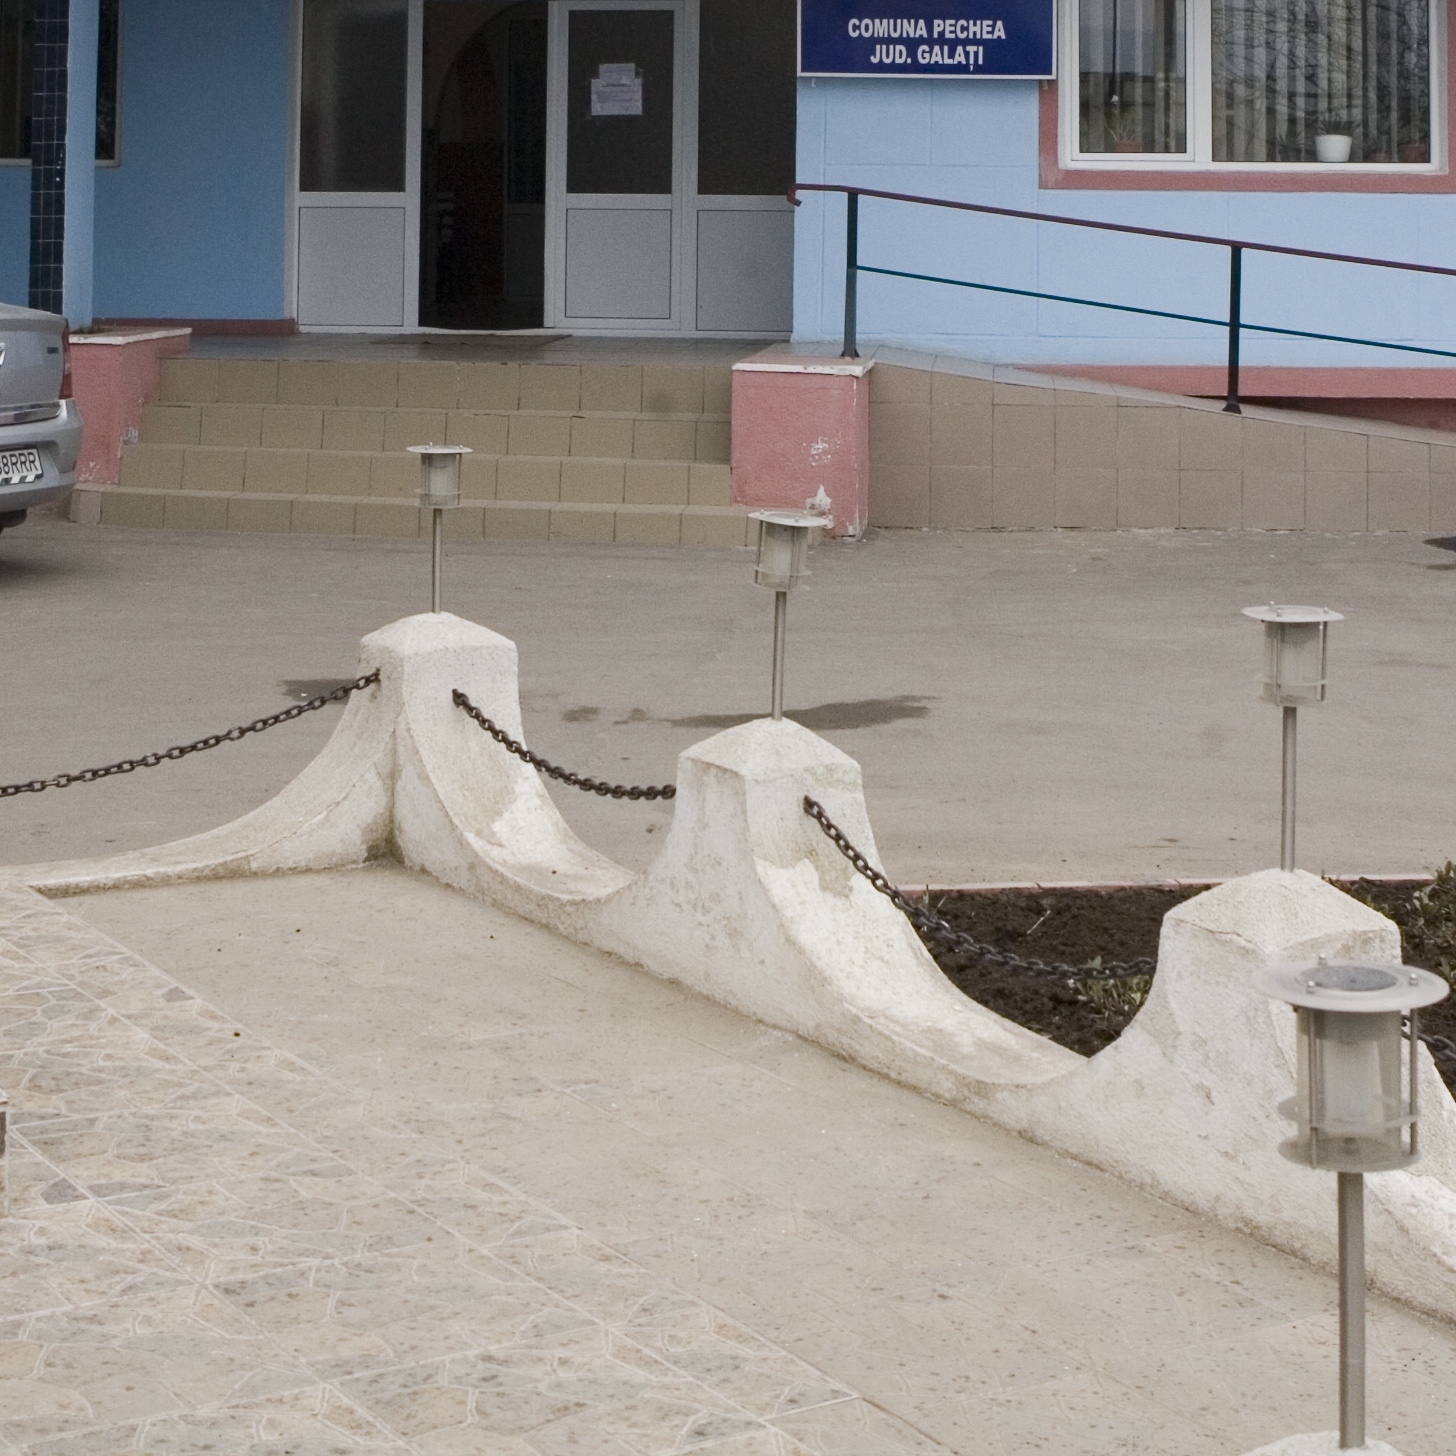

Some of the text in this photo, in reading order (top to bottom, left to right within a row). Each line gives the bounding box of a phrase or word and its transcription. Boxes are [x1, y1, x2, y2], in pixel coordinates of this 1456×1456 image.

[848, 18, 1006, 40] COMUNA PECHEA
[870, 45, 983, 72] JUD. GALAȚI
